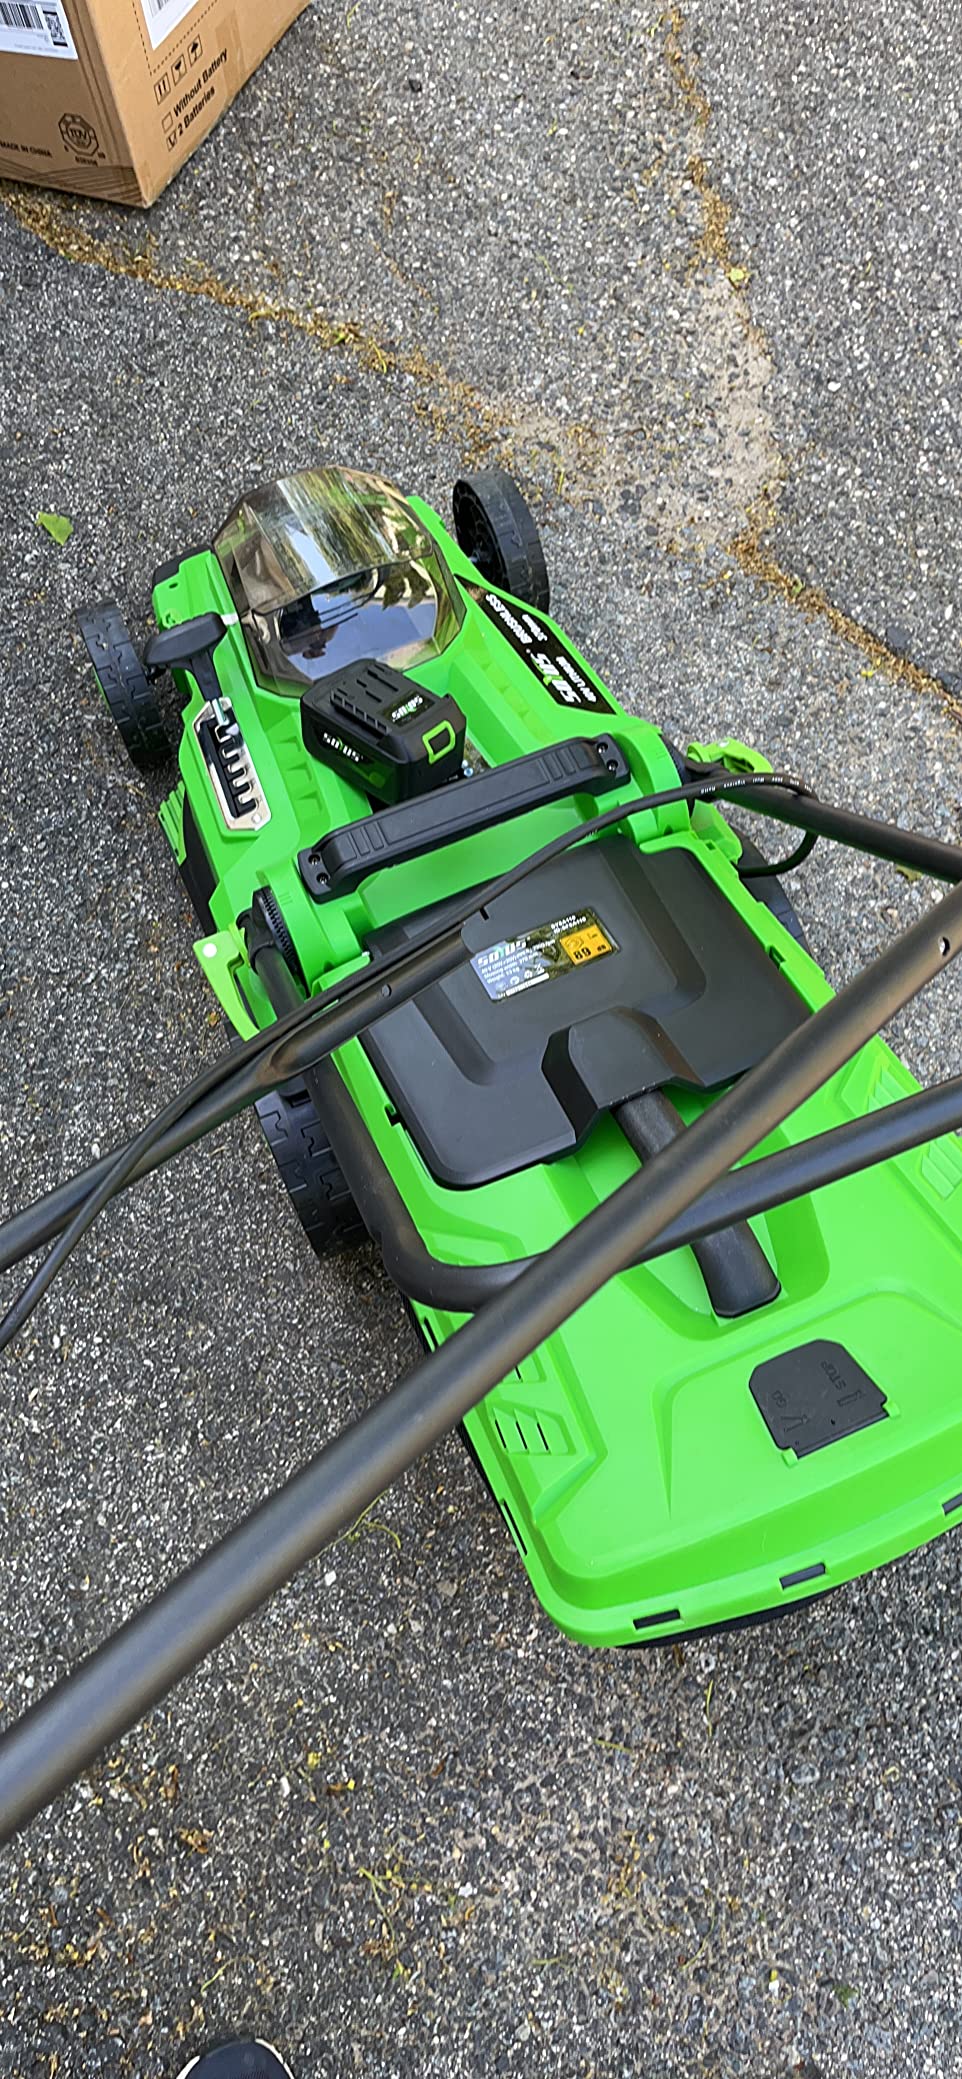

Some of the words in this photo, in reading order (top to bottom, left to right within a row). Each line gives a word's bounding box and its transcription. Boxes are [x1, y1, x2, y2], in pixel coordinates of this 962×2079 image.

[173, 79, 202, 117] Without
[202, 48, 227, 84] Battery
[178, 122, 184, 136] 2
[183, 86, 215, 129] Batteries
[29, 145, 53, 158] CHINA
[485, 593, 533, 644] BRUSHLESS
[820, 1360, 848, 1391] STOP
